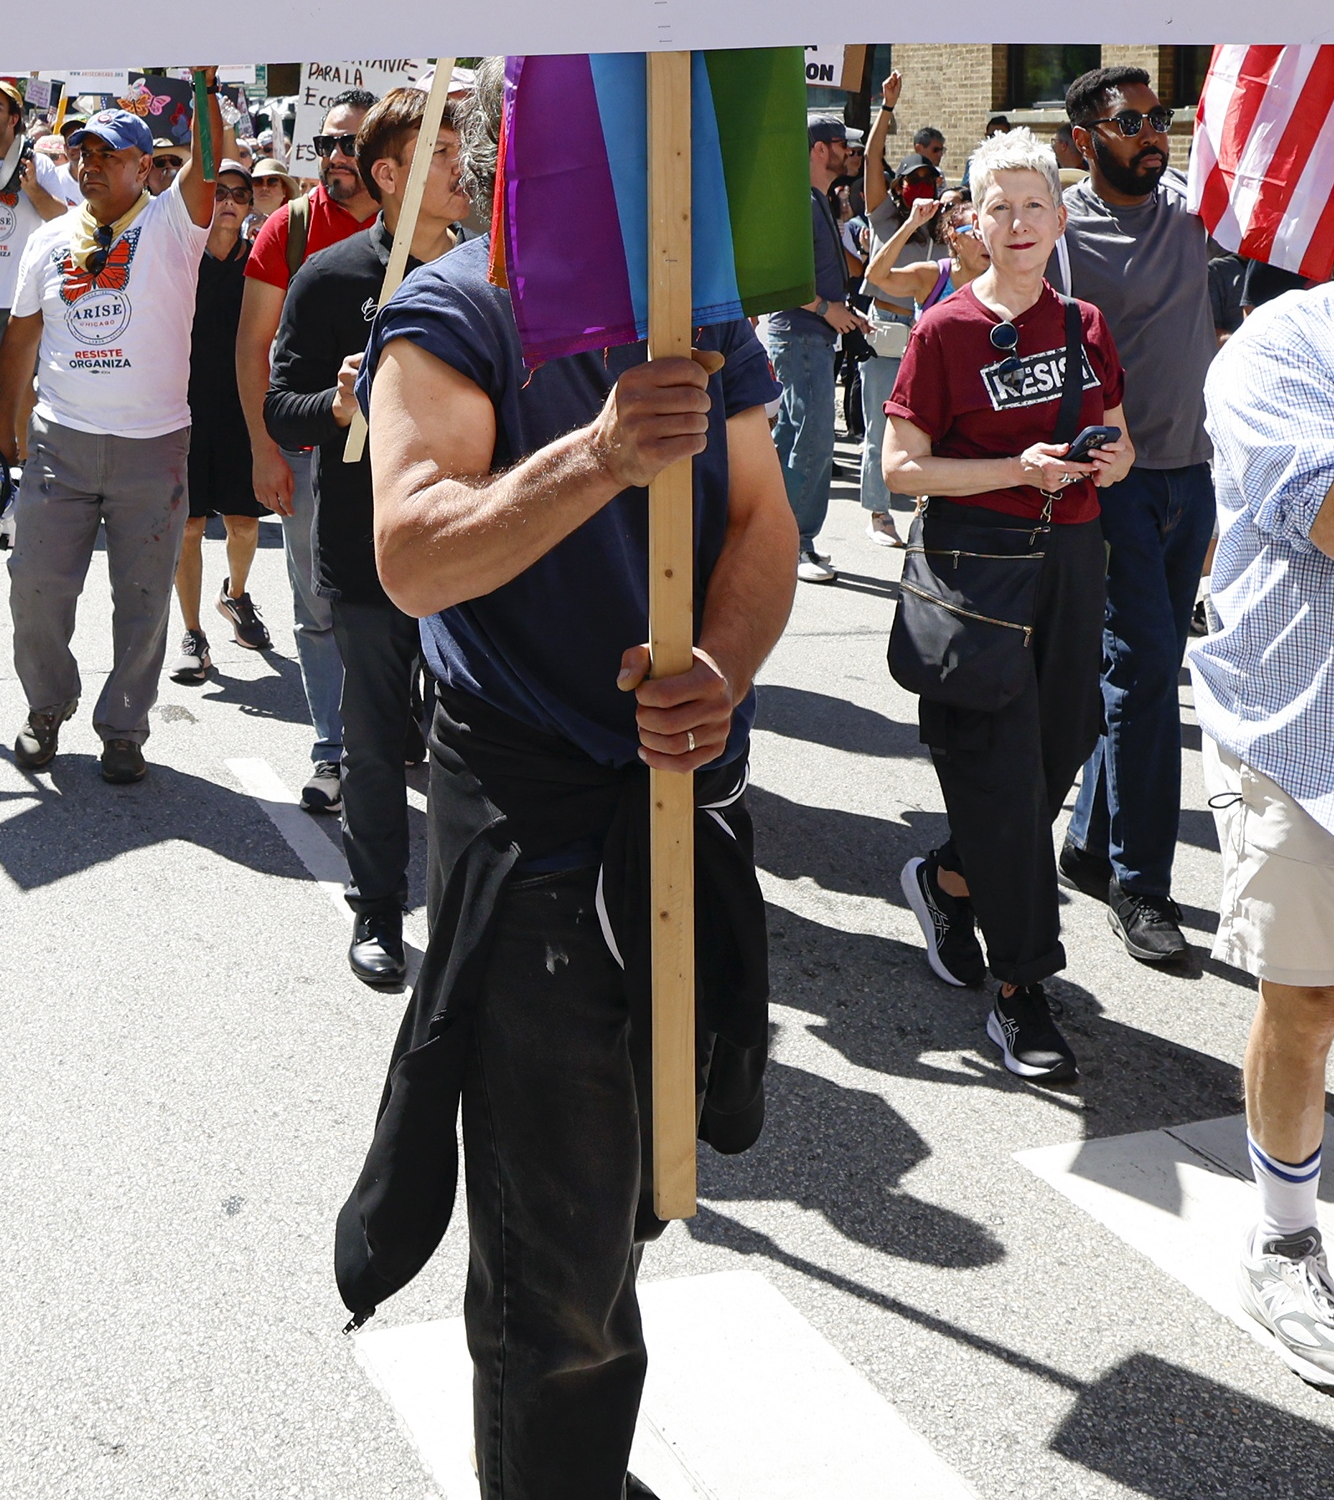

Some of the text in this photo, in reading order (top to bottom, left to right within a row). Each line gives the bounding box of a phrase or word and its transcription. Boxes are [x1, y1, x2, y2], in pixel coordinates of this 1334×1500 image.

[308, 62, 364, 88] PARA LA
[73, 303, 123, 321] ARISE
[79, 319, 116, 328] CHICAGO
[74, 348, 123, 360] RESISTE
[68, 358, 132, 370] ORGANIZA
